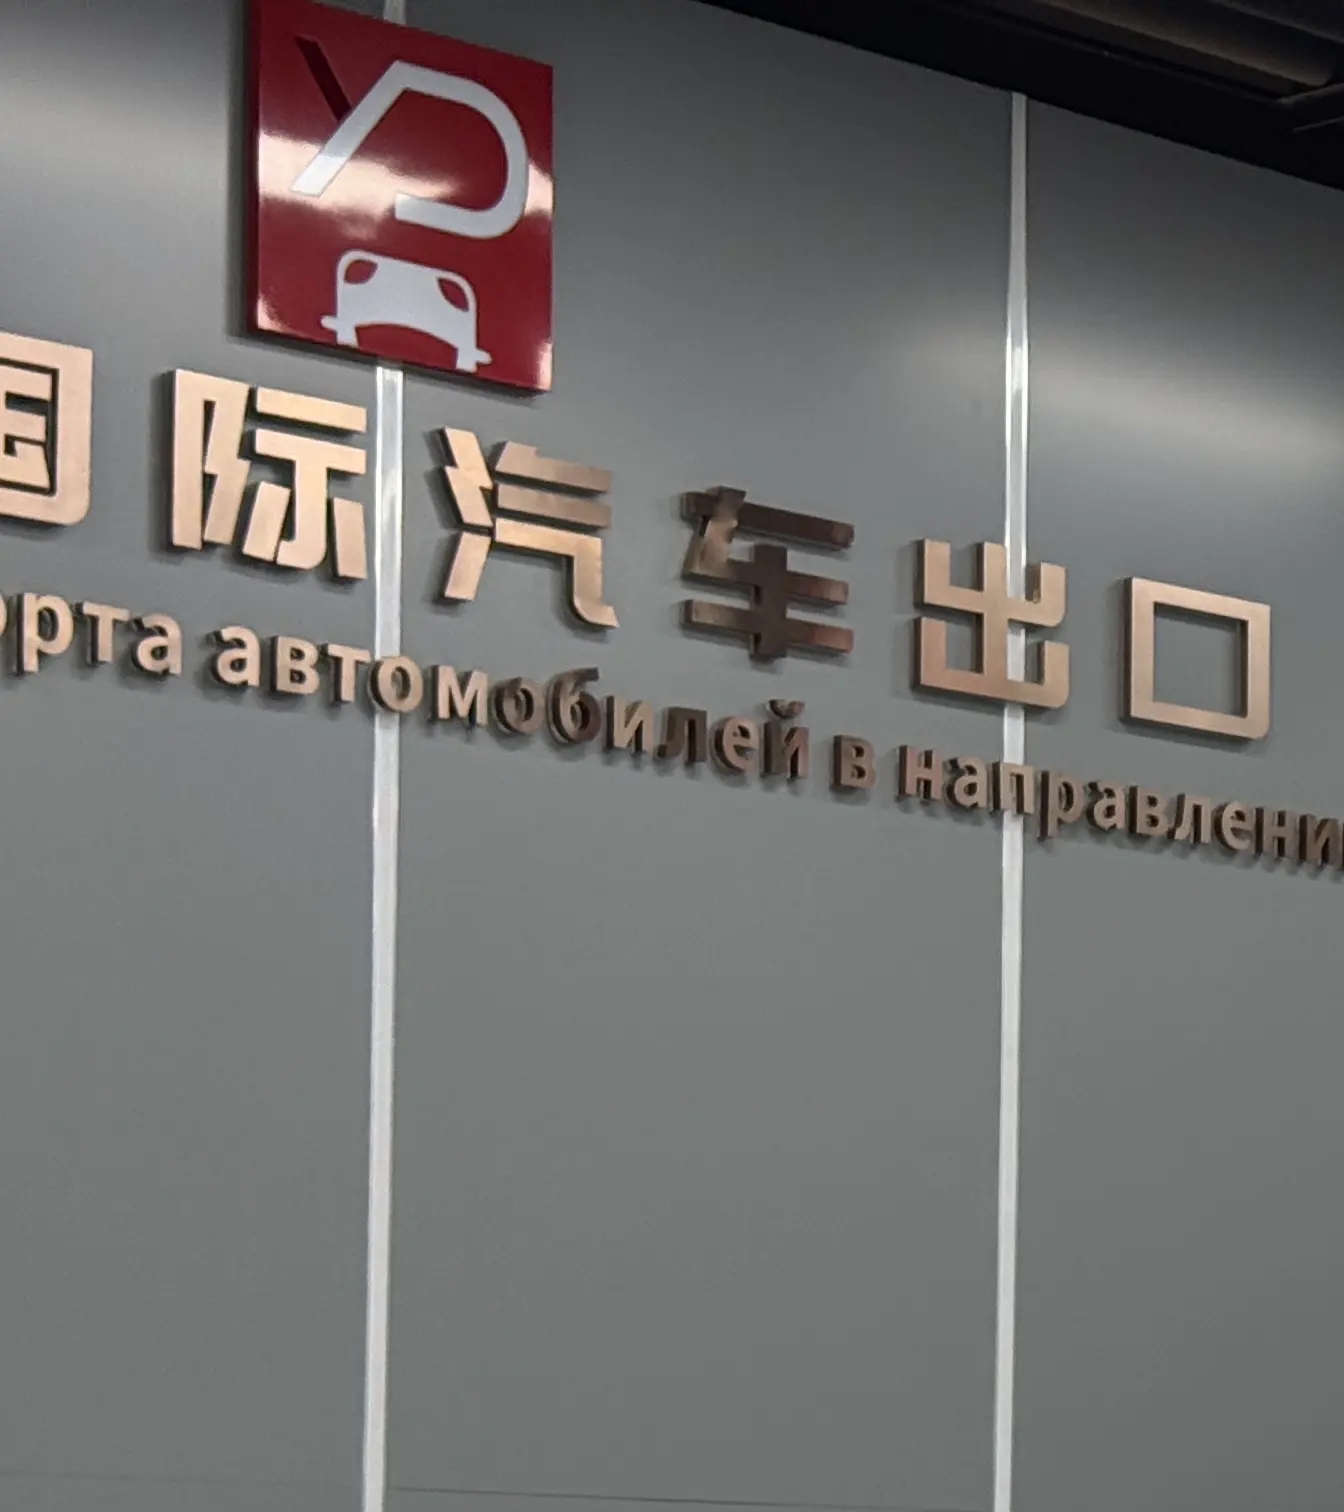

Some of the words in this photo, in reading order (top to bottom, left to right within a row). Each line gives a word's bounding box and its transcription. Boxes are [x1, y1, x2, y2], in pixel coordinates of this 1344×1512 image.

[0, 588, 183, 675] рта
[208, 624, 809, 779] автомобилей
[833, 733, 876, 791] в
